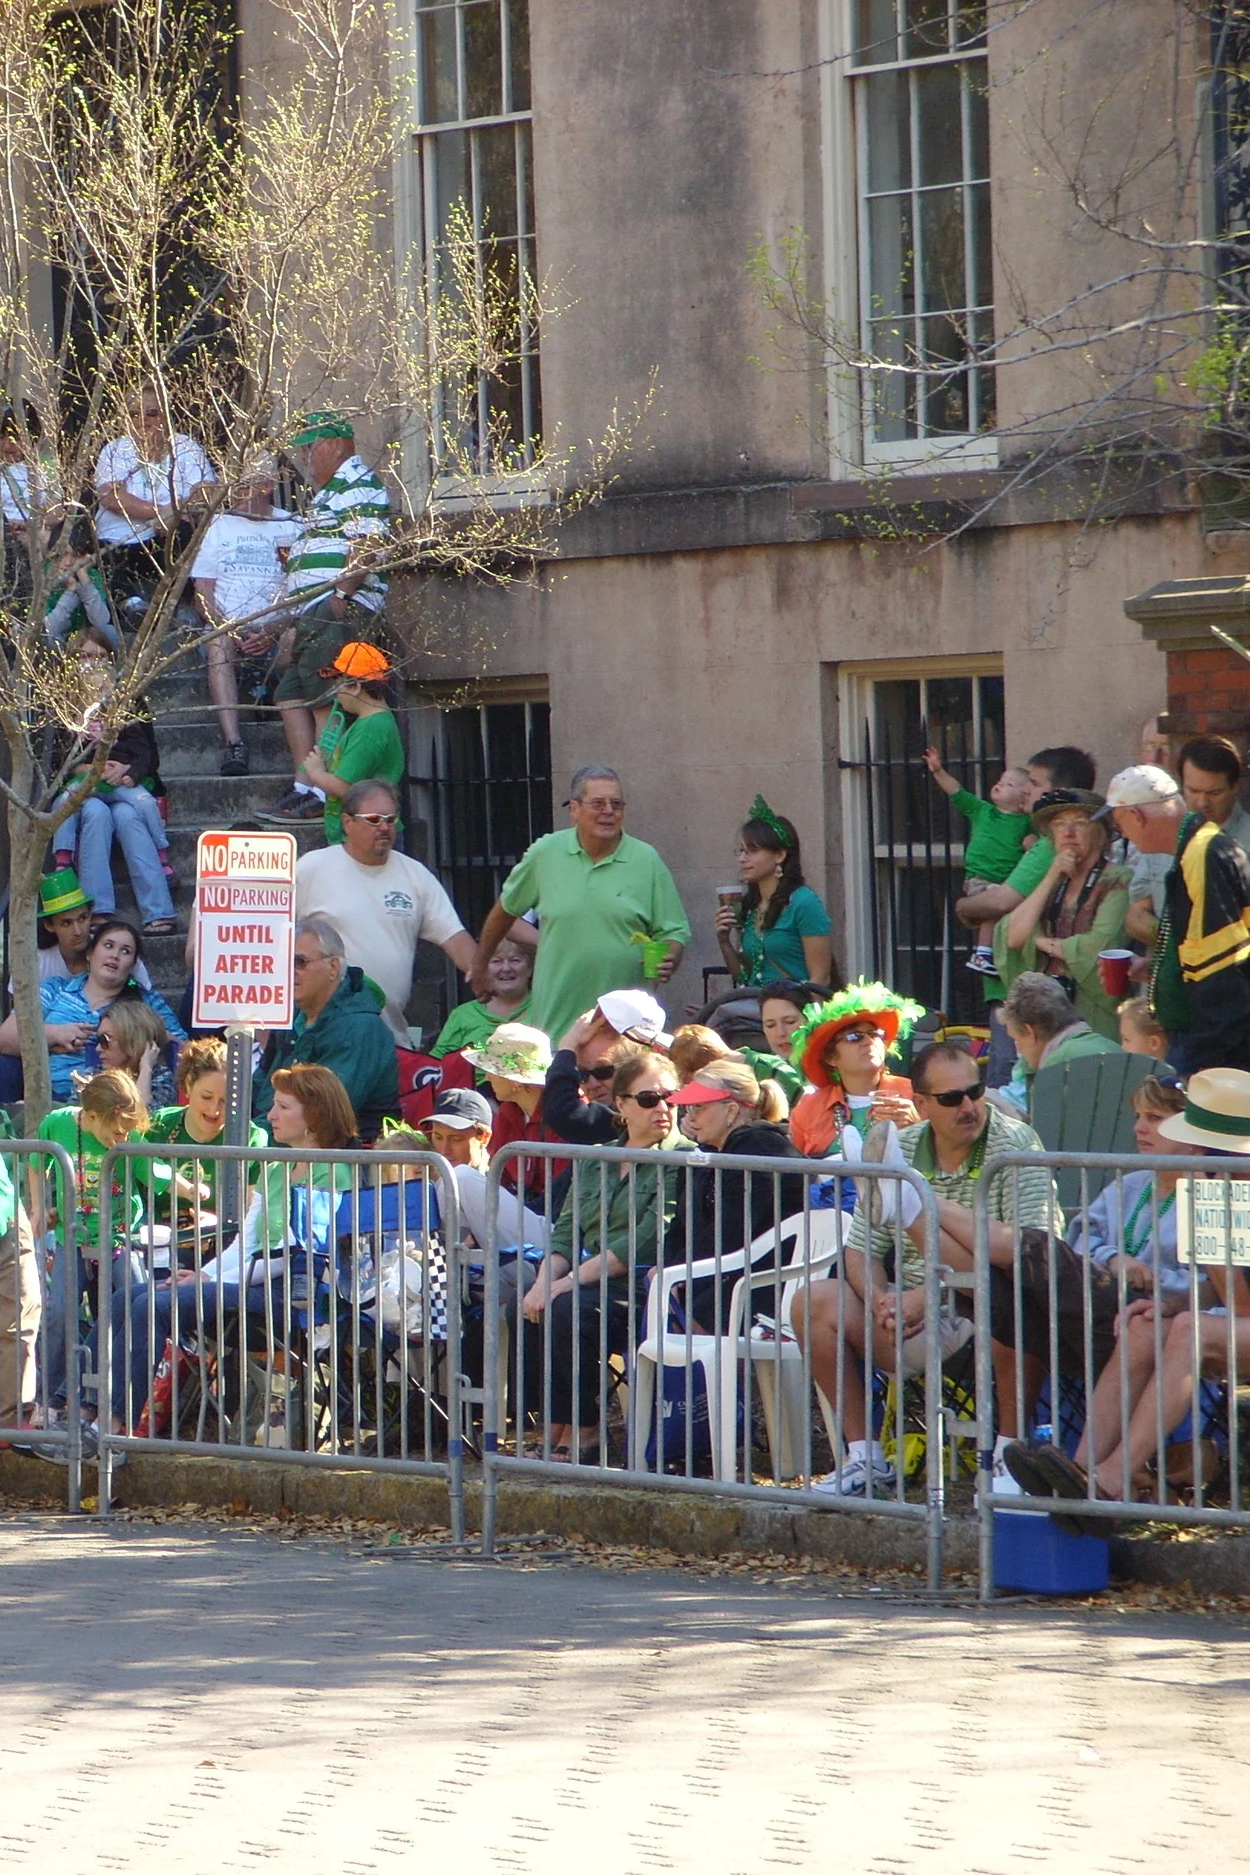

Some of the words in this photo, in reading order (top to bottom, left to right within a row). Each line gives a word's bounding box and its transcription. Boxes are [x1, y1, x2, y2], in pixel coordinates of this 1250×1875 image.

[201, 845, 228, 872] NO
[231, 851, 289, 870] PARKING
[204, 886, 230, 908] NO
[233, 888, 289, 907] PARKING
[217, 925, 274, 944] UNTIL
[214, 954, 274, 974] AFTER
[203, 984, 284, 1005] PARADE
